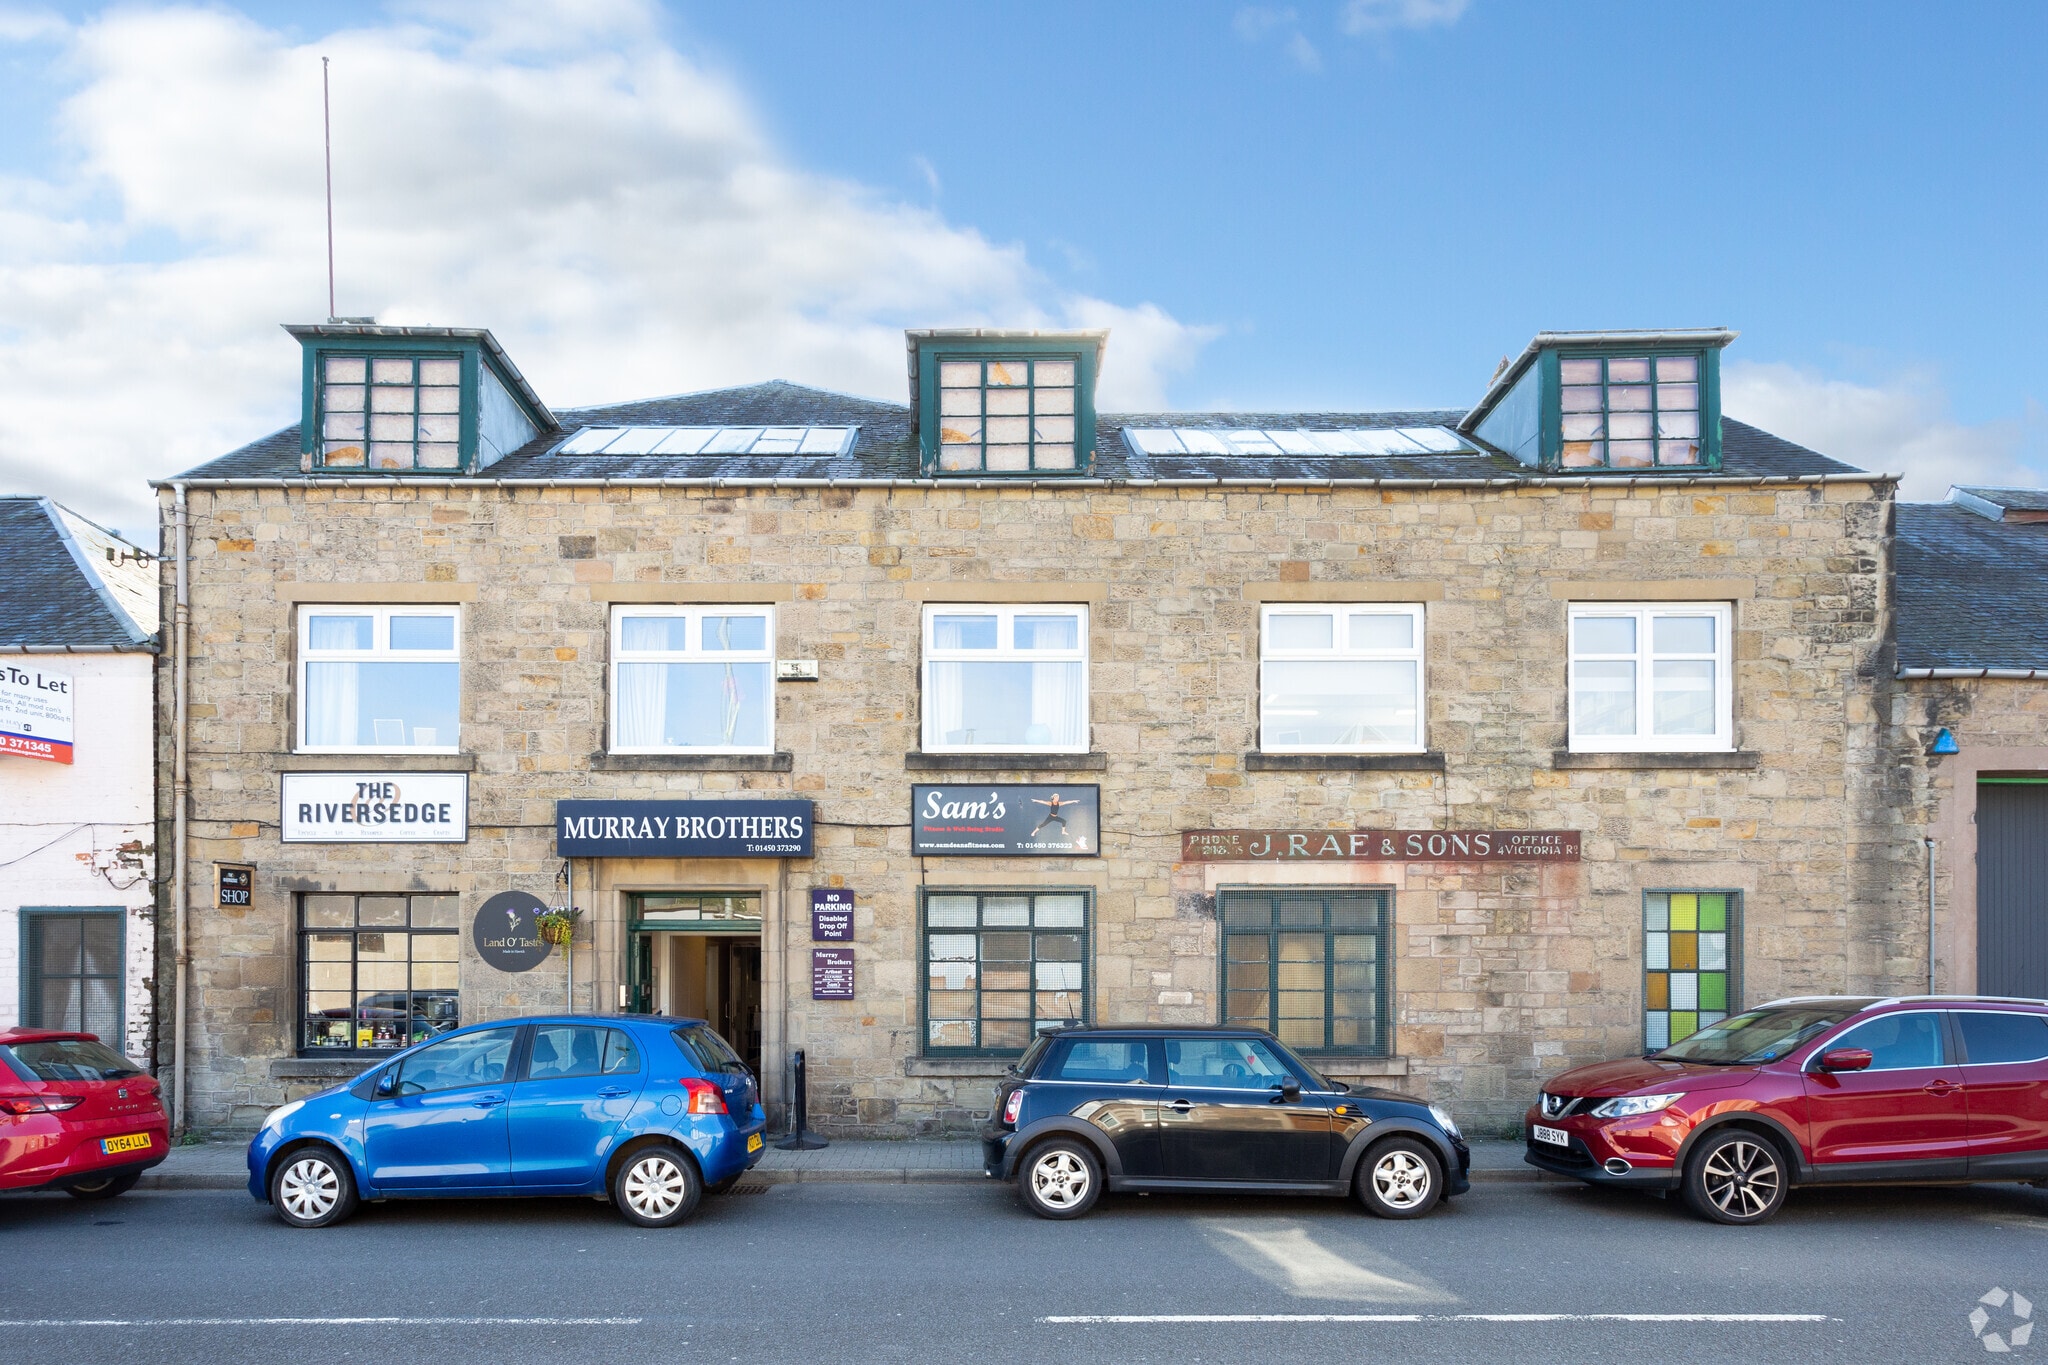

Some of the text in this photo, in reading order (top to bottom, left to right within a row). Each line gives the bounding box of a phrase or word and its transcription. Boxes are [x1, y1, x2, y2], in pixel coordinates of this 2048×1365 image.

[37, 673, 67, 694] Let
[14, 693, 31, 701] many
[15, 706, 28, 714] 2nd
[9, 738, 52, 753] 371345
[355, 782, 393, 799] THE
[922, 791, 1006, 819] Sam's
[298, 803, 452, 824] RIVERSEDGE
[563, 816, 803, 839] MURRAY BROTHERS
[755, 844, 776, 852] 01450
[776, 844, 802, 852] 373290
[1190, 835, 1240, 845] PHONE
[1380, 838, 1397, 856] &
[1405, 834, 1492, 857] SONS
[1505, 845, 1561, 855] VICTORIA
[221, 889, 249, 903] SHOP
[827, 894, 840, 902] NO
[814, 903, 853, 911] PARKING
[483, 938, 505, 947] Land
[1537, 1127, 1565, 1143] J888 SYK
[107, 1135, 149, 1152] OY64 LLN
